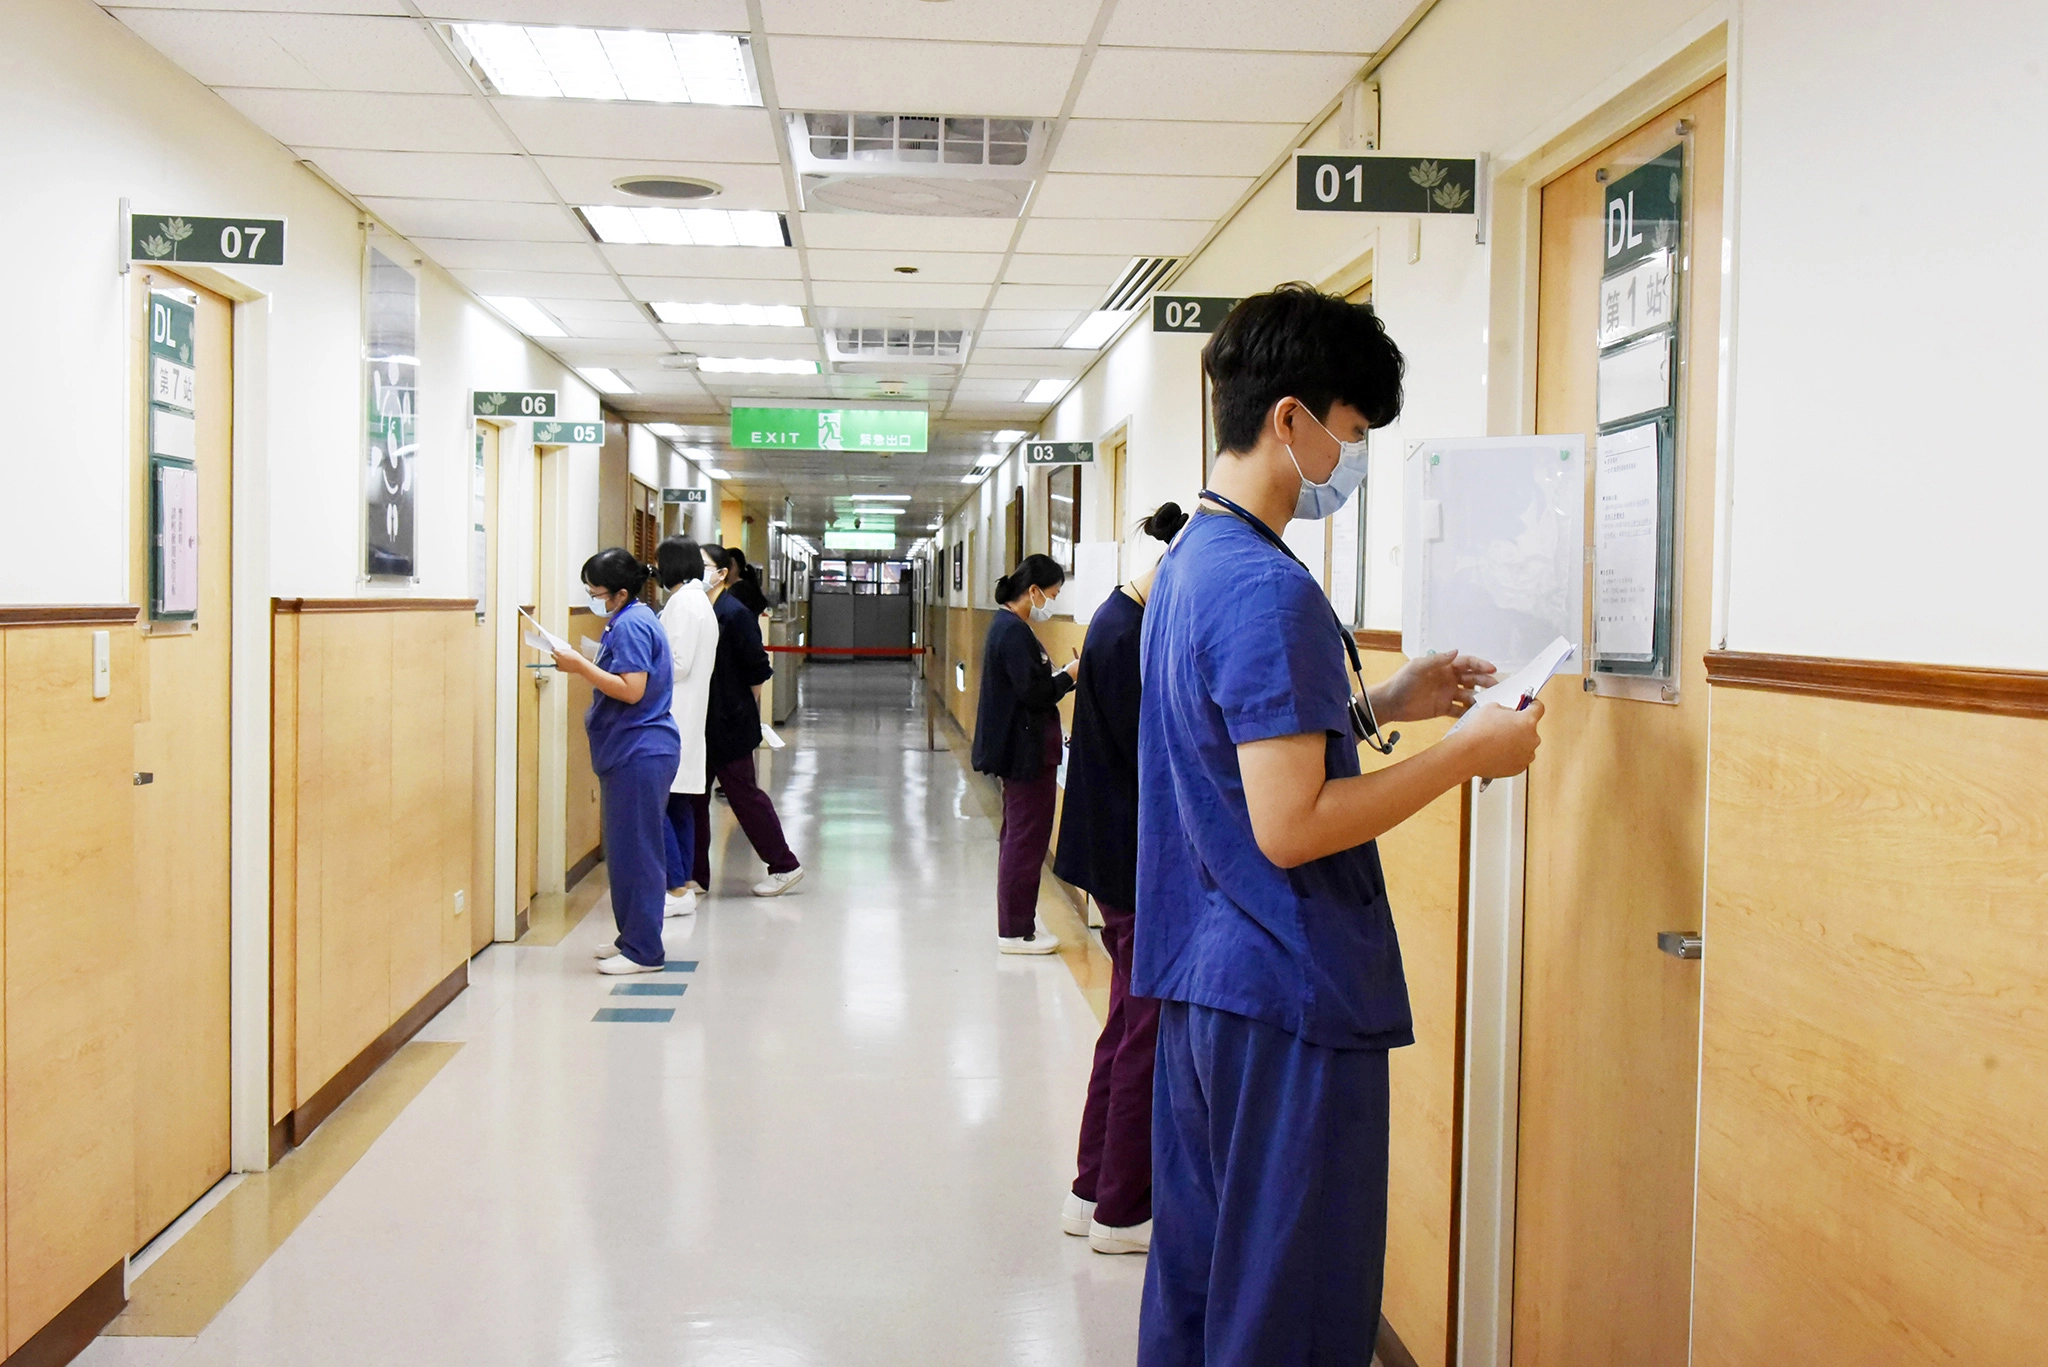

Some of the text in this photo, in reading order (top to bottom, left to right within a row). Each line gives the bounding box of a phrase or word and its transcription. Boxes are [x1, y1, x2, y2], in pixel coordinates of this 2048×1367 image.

[1315, 164, 1362, 203] 01
[1607, 190, 1643, 259] DL
[220, 226, 267, 259] 07
[1165, 301, 1201, 328] 02
[153, 302, 176, 348] DL
[521, 395, 547, 415] 06
[573, 425, 596, 442] 05
[751, 431, 800, 444] EXIT
[859, 433, 911, 447] 緊急出口
[1033, 445, 1054, 461] 03
[687, 490, 702, 502] 04
